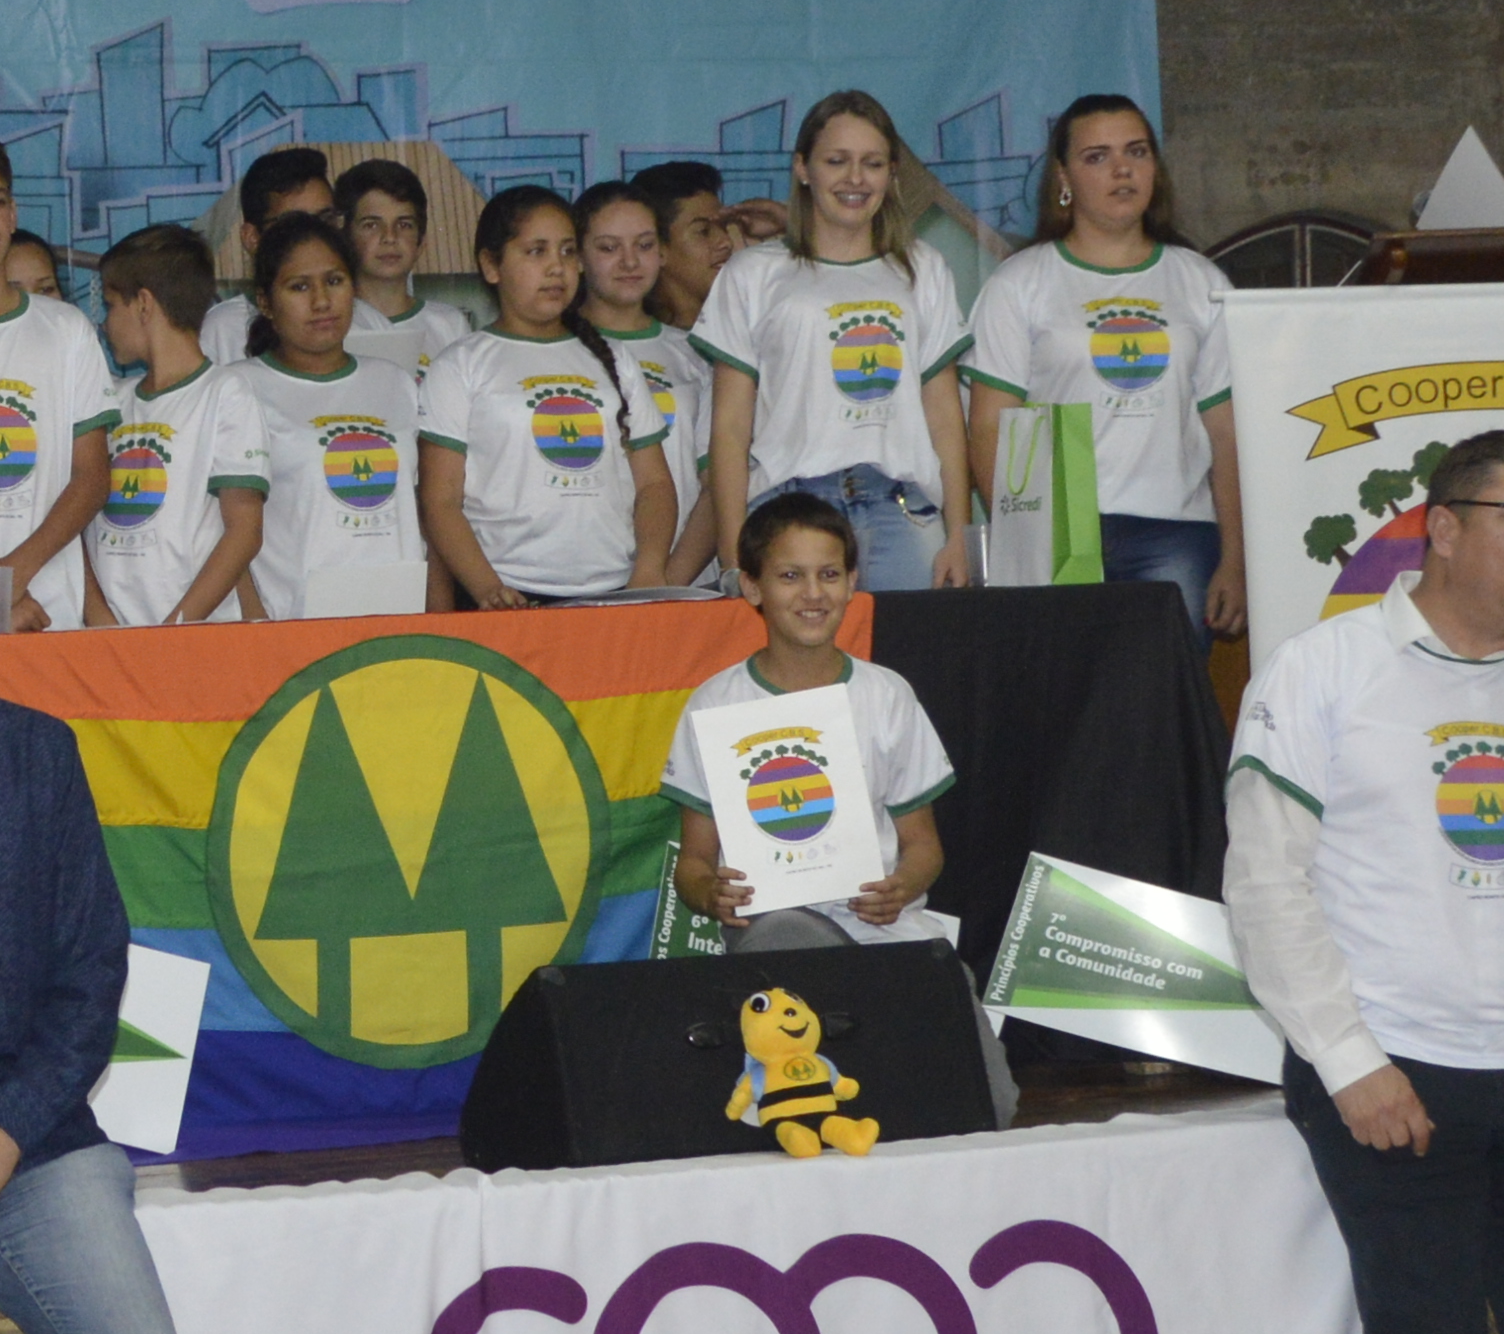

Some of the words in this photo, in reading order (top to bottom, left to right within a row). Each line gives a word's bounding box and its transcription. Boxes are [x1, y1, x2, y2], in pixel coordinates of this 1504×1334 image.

[1354, 374, 1503, 416] Cooper
[1010, 496, 1042, 513] Sicredi
[990, 942, 1020, 1001] Princípios
[1010, 865, 1045, 941] Cooperativos
[1044, 925, 1162, 969] Compromisso
[1166, 960, 1204, 981] com
[1038, 946, 1052, 959] a
[1055, 948, 1167, 991] Comunidade
